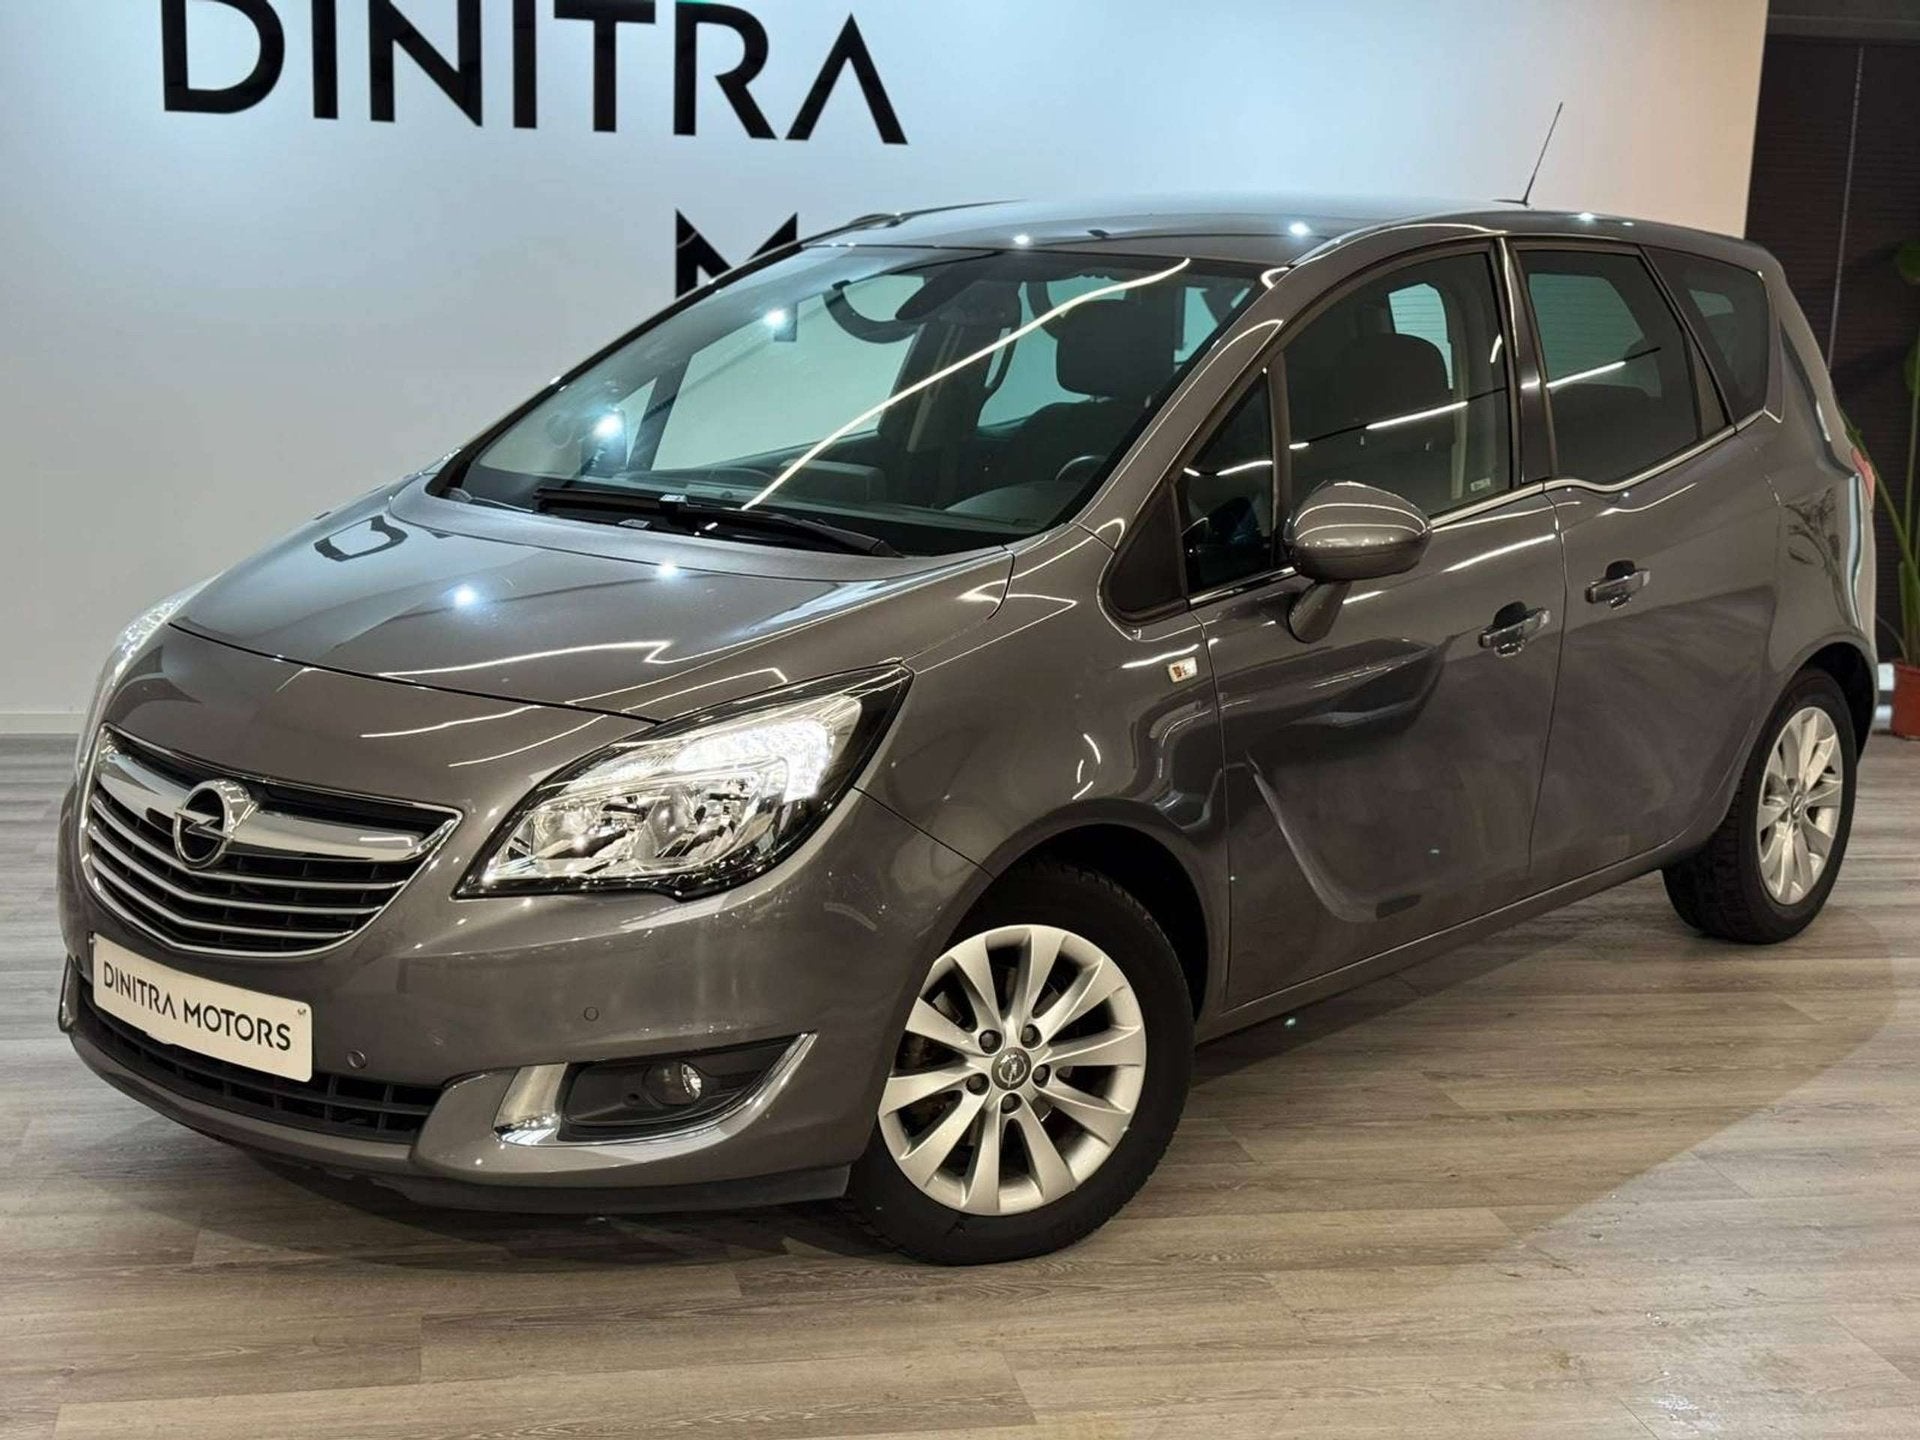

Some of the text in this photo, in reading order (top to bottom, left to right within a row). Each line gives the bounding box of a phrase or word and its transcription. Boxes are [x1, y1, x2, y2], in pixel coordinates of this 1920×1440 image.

[162, 0, 908, 145] DINITRA
[103, 961, 291, 1051] DINITRA MOTORS
